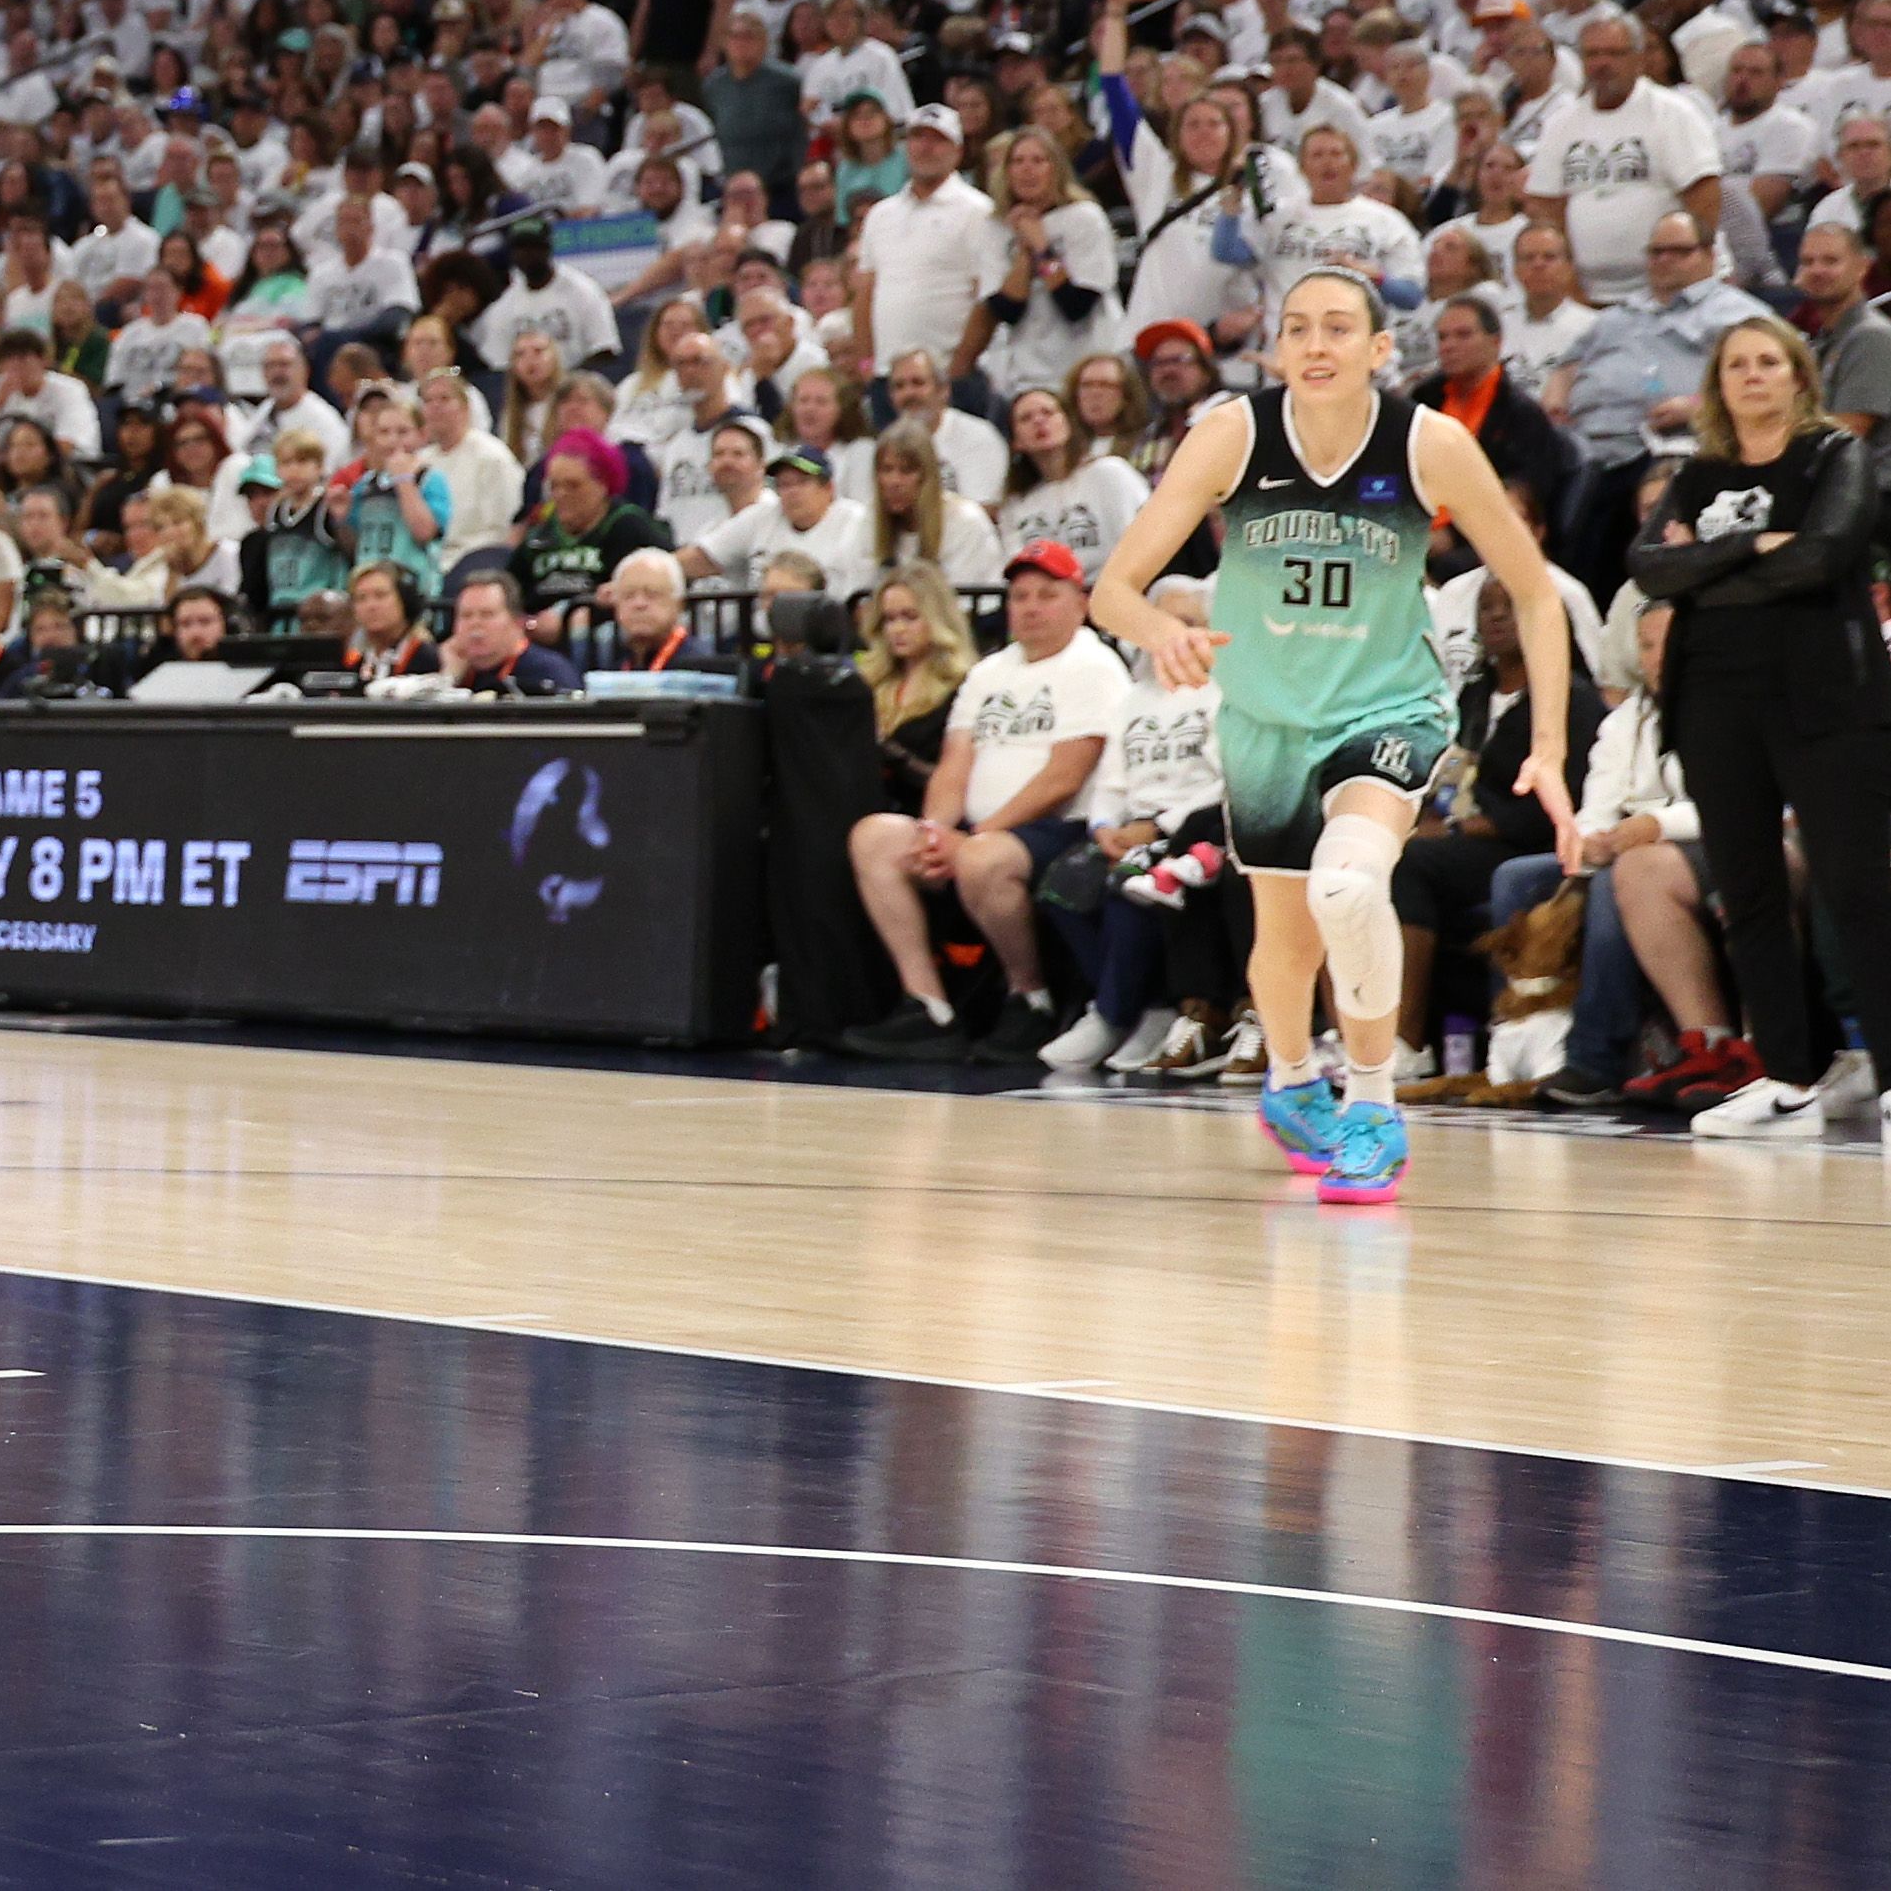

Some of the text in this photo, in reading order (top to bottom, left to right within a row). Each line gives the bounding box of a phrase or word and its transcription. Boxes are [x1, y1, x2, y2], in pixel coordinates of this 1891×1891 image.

[1280, 556, 1354, 608] 30
[74, 769, 103, 818] 5
[28, 836, 64, 902] 8
[78, 837, 166, 905] PM
[180, 839, 251, 907] ET
[284, 840, 444, 906] ESPN
